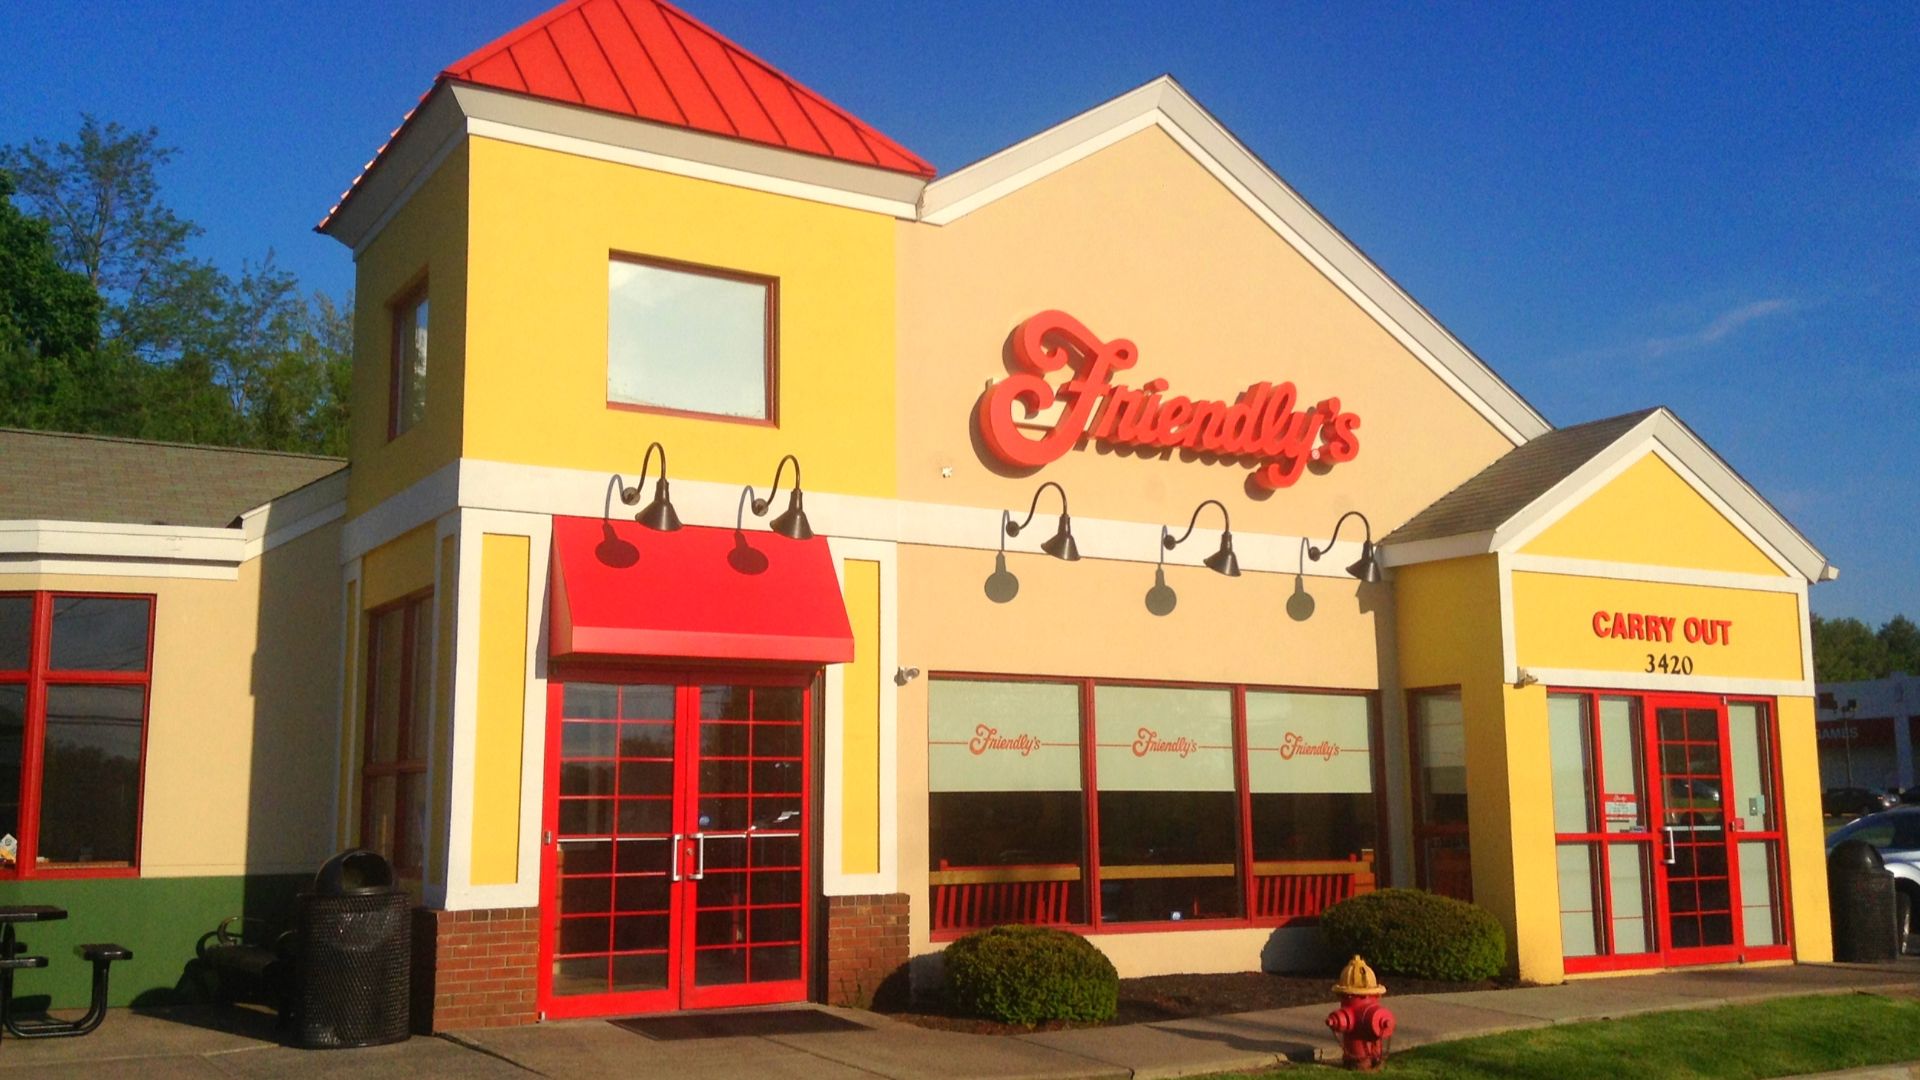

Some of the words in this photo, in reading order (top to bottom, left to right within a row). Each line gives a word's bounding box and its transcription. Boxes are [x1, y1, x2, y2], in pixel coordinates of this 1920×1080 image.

[980, 310, 1361, 488] Friendly's
[1592, 610, 1676, 643] CARRY
[1683, 617, 1732, 646] OUT
[1644, 653, 1694, 676] 3420
[969, 723, 1041, 757] Friendly's
[1131, 727, 1197, 759] Friendly's
[1280, 731, 1340, 761] Friendly's
